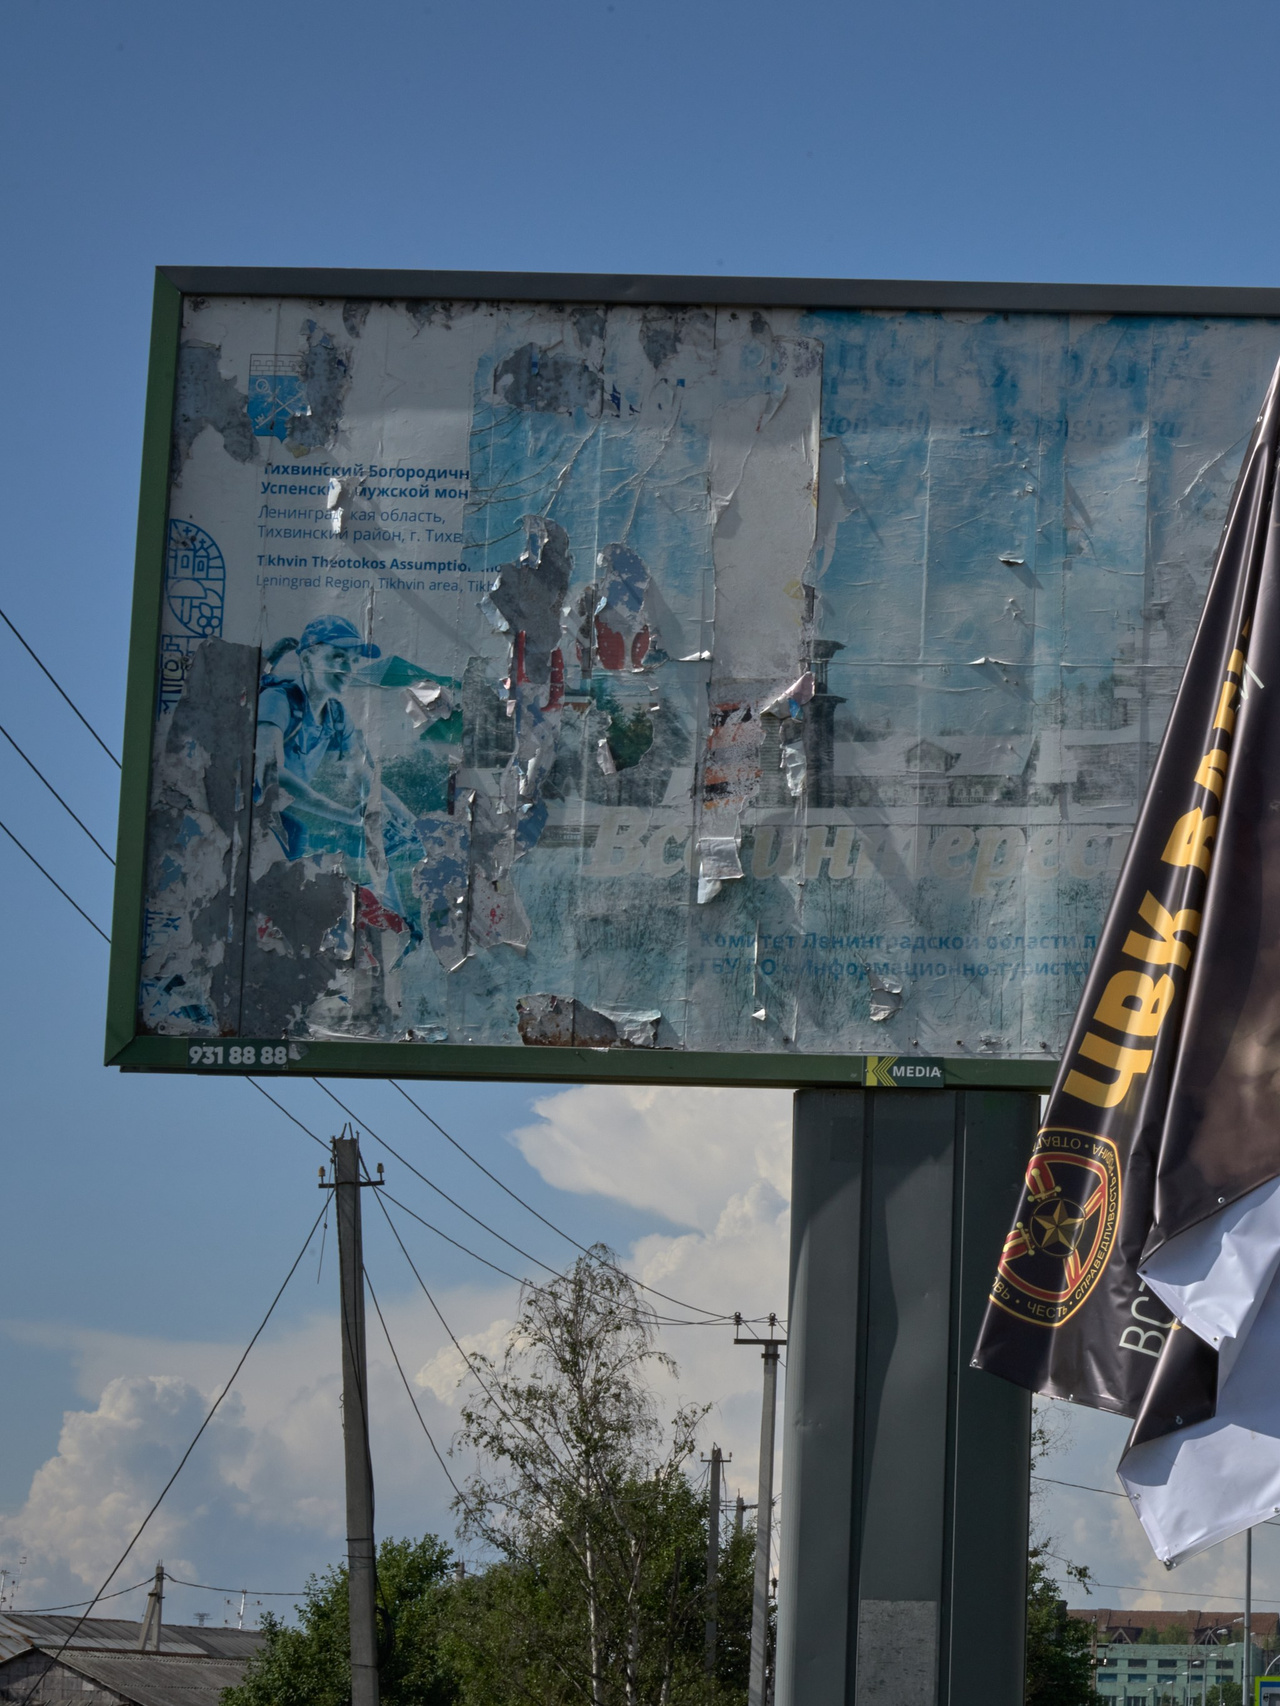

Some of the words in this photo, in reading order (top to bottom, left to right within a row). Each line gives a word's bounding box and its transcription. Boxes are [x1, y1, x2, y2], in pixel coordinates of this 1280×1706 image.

[369, 464, 470, 481] Богородичн
[434, 490, 469, 500] мон
[381, 508, 446, 525] область,
[257, 525, 349, 541] Тихвинский
[353, 528, 405, 544] район,
[410, 532, 420, 543] г.
[312, 556, 386, 570] Theotokos
[256, 575, 321, 590] Leningrad
[378, 578, 425, 590] Tikhvin
[429, 581, 464, 593] area,
[189, 1046, 224, 1065] 931
[229, 1046, 257, 1065] 88
[261, 1046, 287, 1065] 88
[892, 1066, 942, 1078] MEDIA
[1026, 1300, 1069, 1319] ЧЕСТЬ
[1075, 1176, 1118, 1300] СПРАВЕДЛИВОСТЬ
